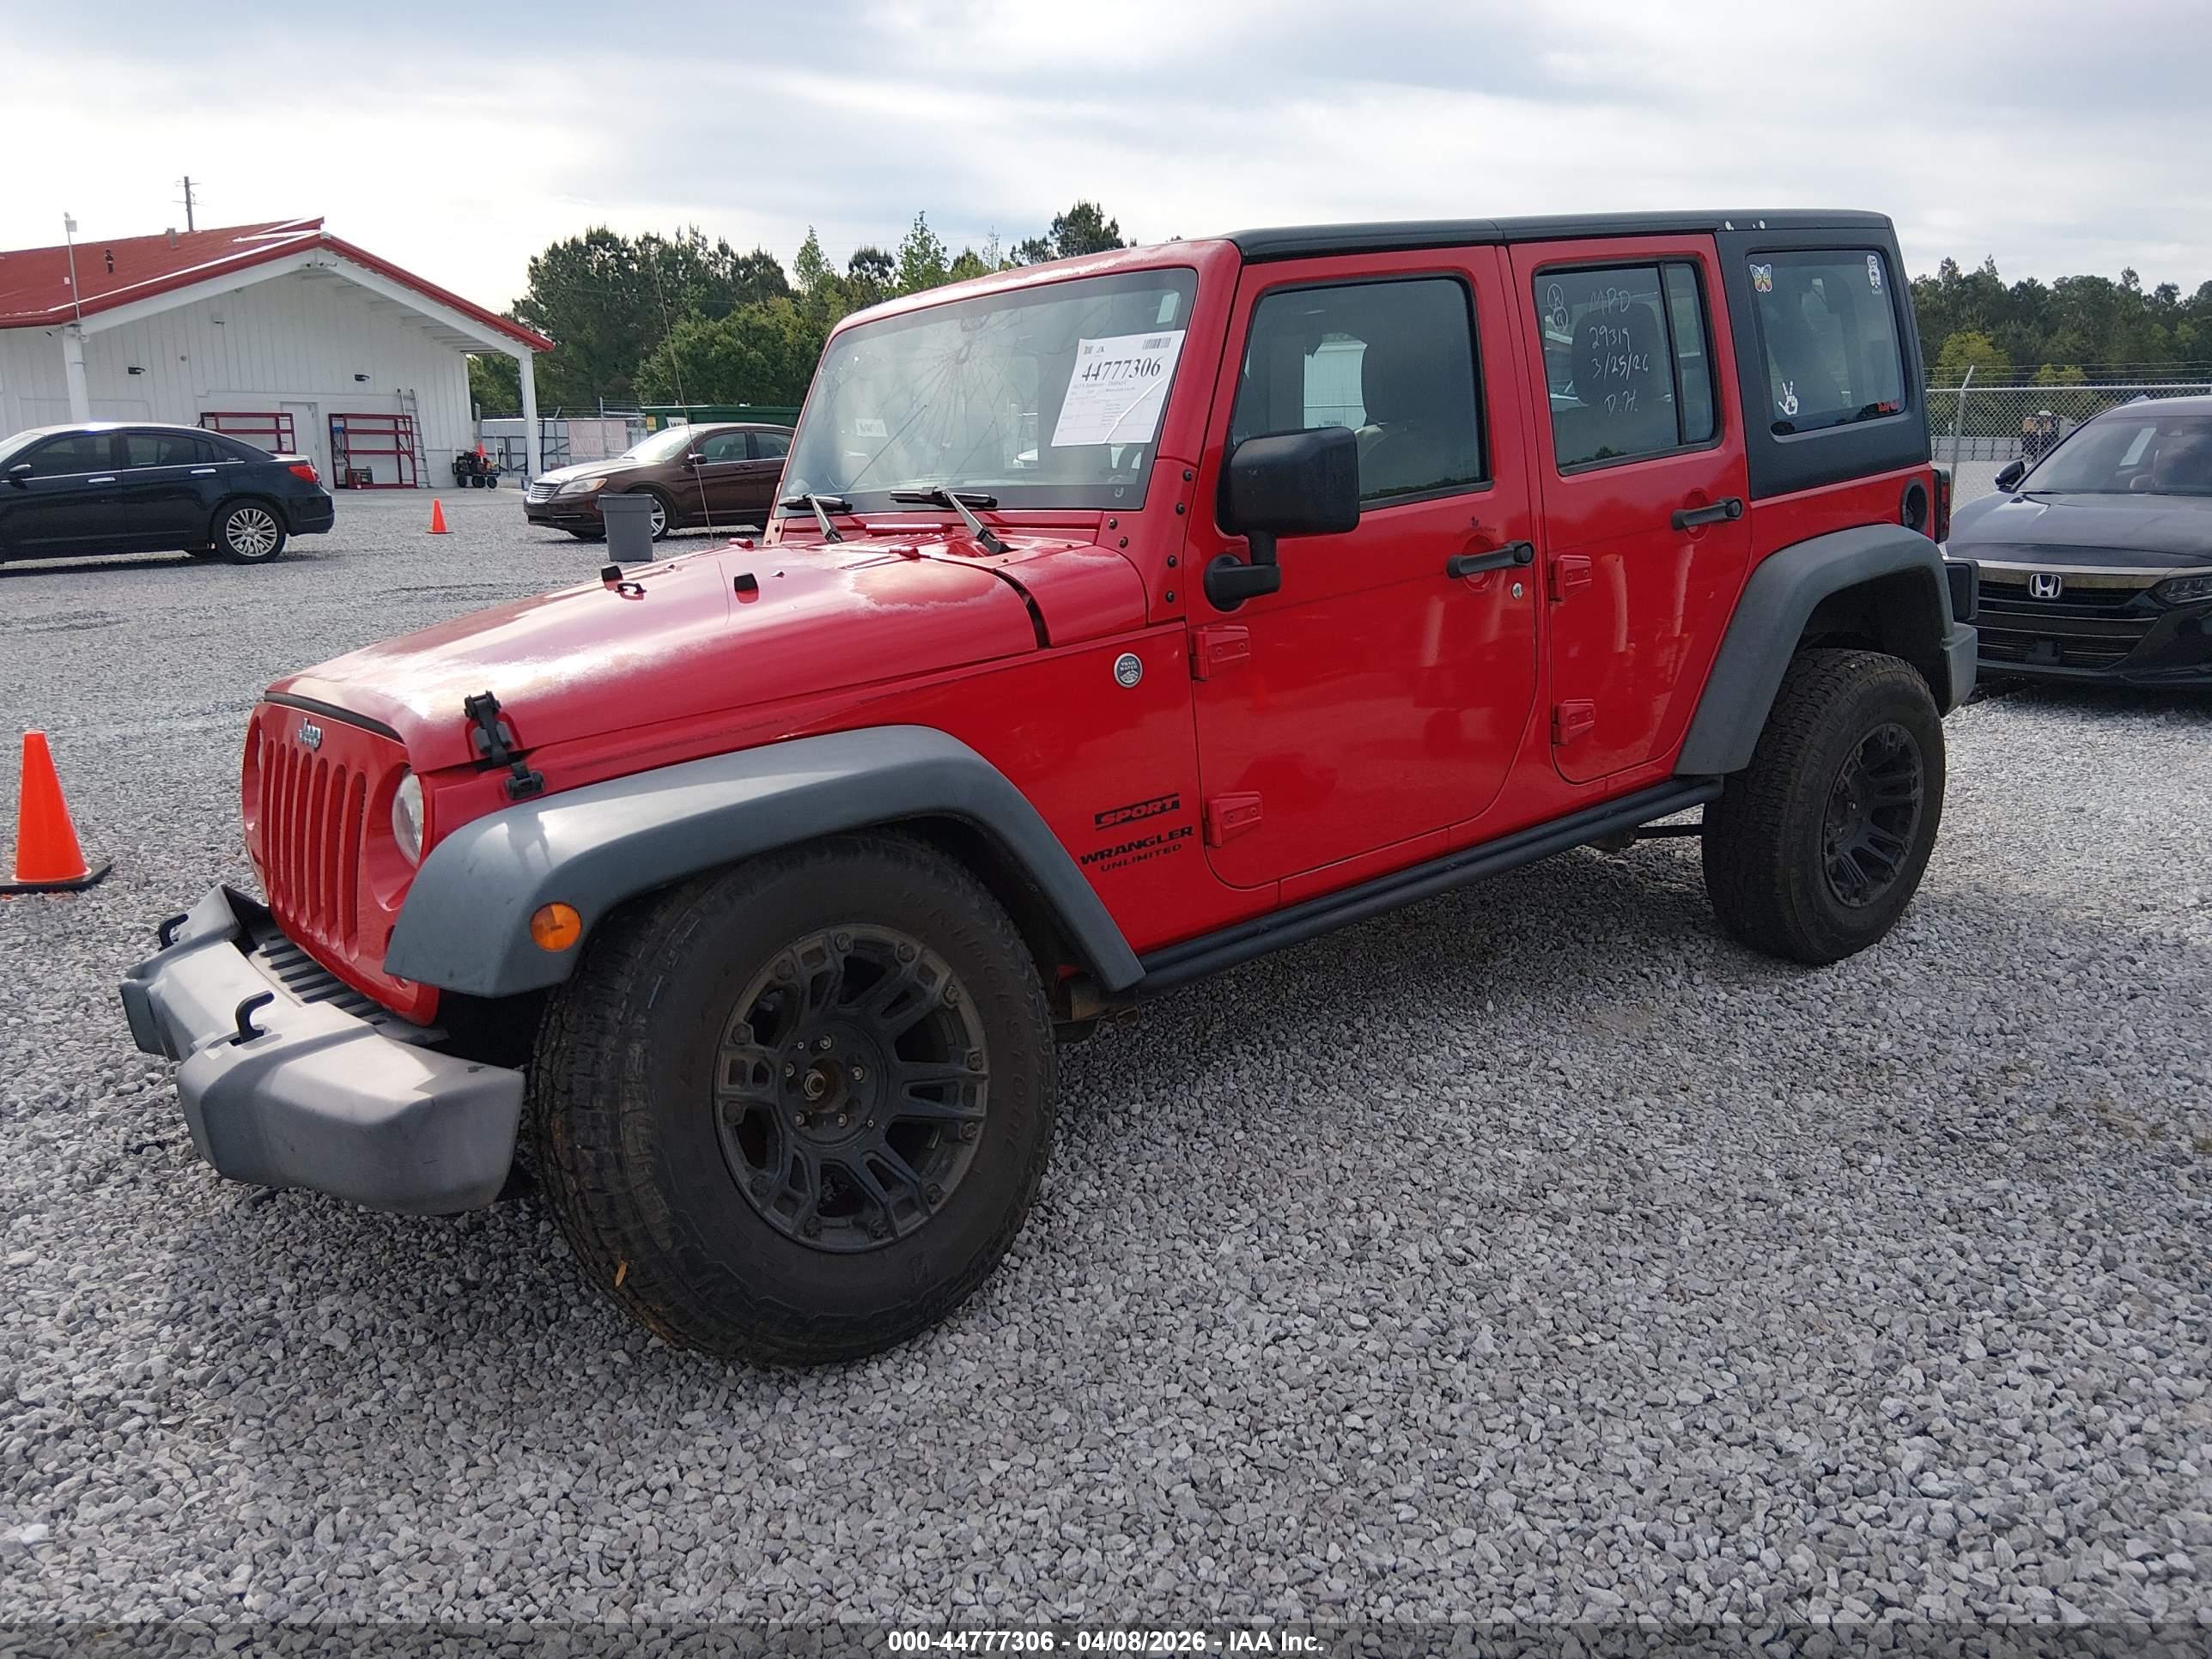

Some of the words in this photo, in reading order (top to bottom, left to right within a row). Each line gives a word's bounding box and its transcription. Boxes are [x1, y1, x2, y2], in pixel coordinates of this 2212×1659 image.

[1589, 288, 1631, 315] MPD
[1589, 325, 1632, 352] 29319
[1082, 357, 1164, 381] 44777306
[1095, 794, 1180, 830] SPORT
[1079, 826, 1194, 866] WRANGLER
[1100, 843, 1182, 872] UNLIMITED
